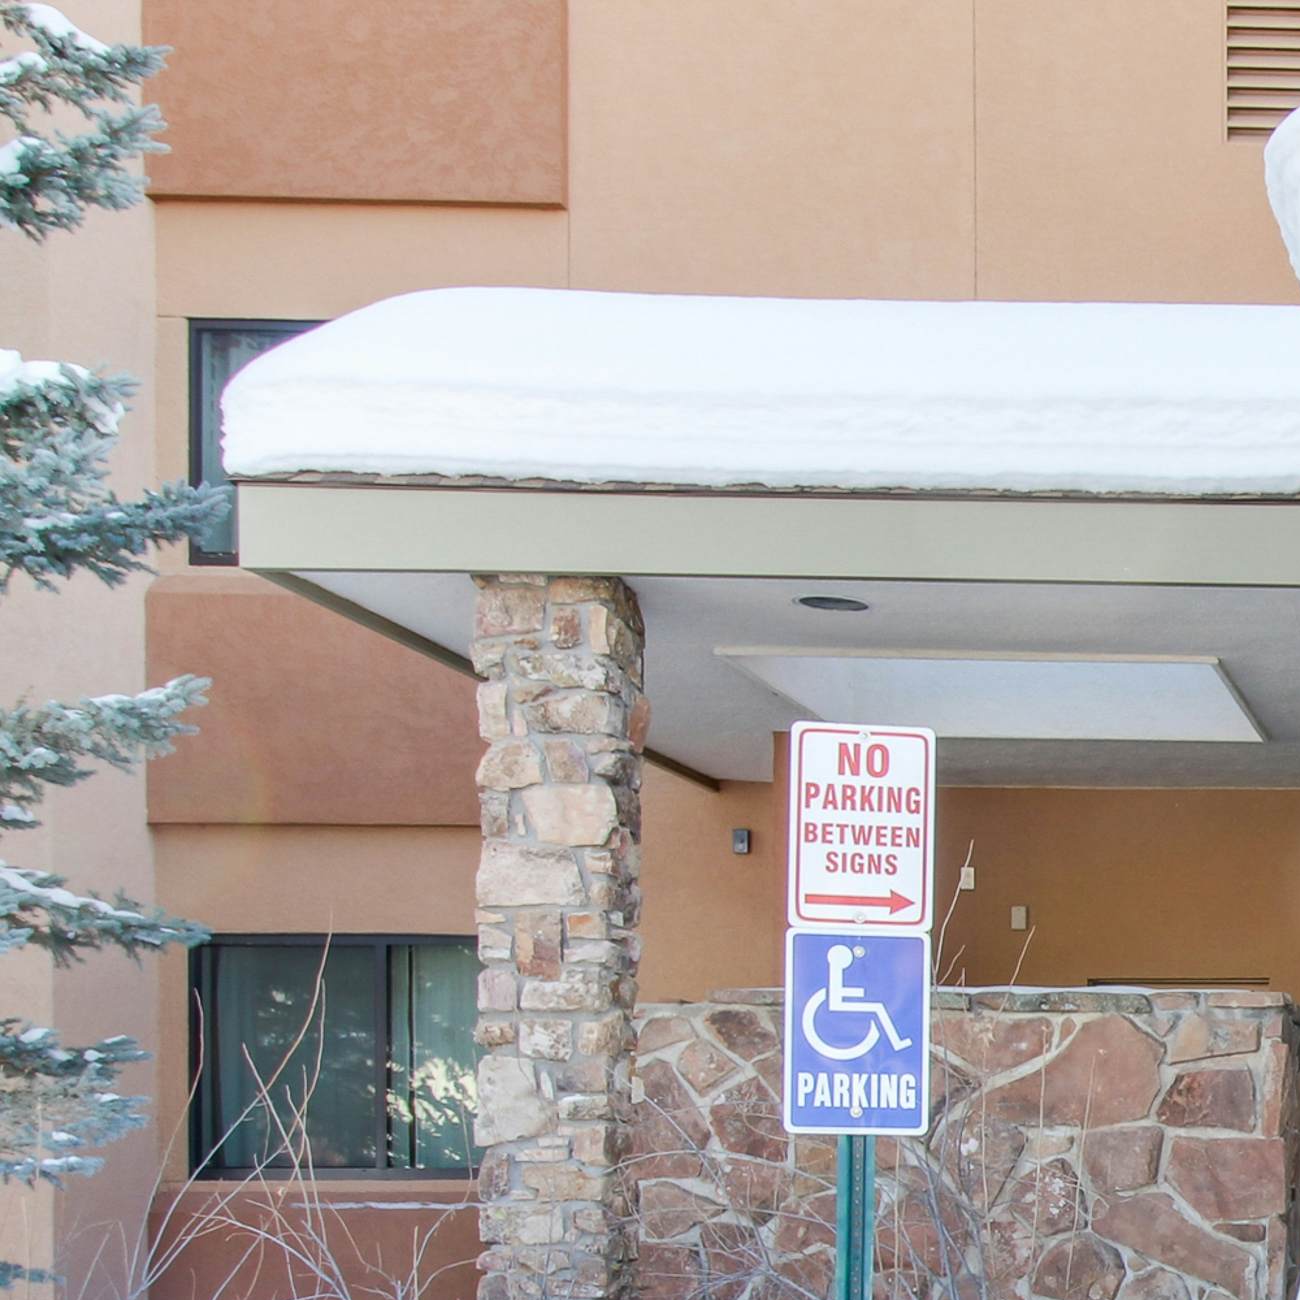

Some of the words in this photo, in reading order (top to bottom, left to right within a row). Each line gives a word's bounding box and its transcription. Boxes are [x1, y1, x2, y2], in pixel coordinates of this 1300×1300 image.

[837, 742, 890, 778] NO
[804, 782, 921, 815] PARKING
[803, 822, 921, 848] BETWEEN
[825, 851, 898, 876] SIGNS
[797, 1072, 917, 1109] PARKING
